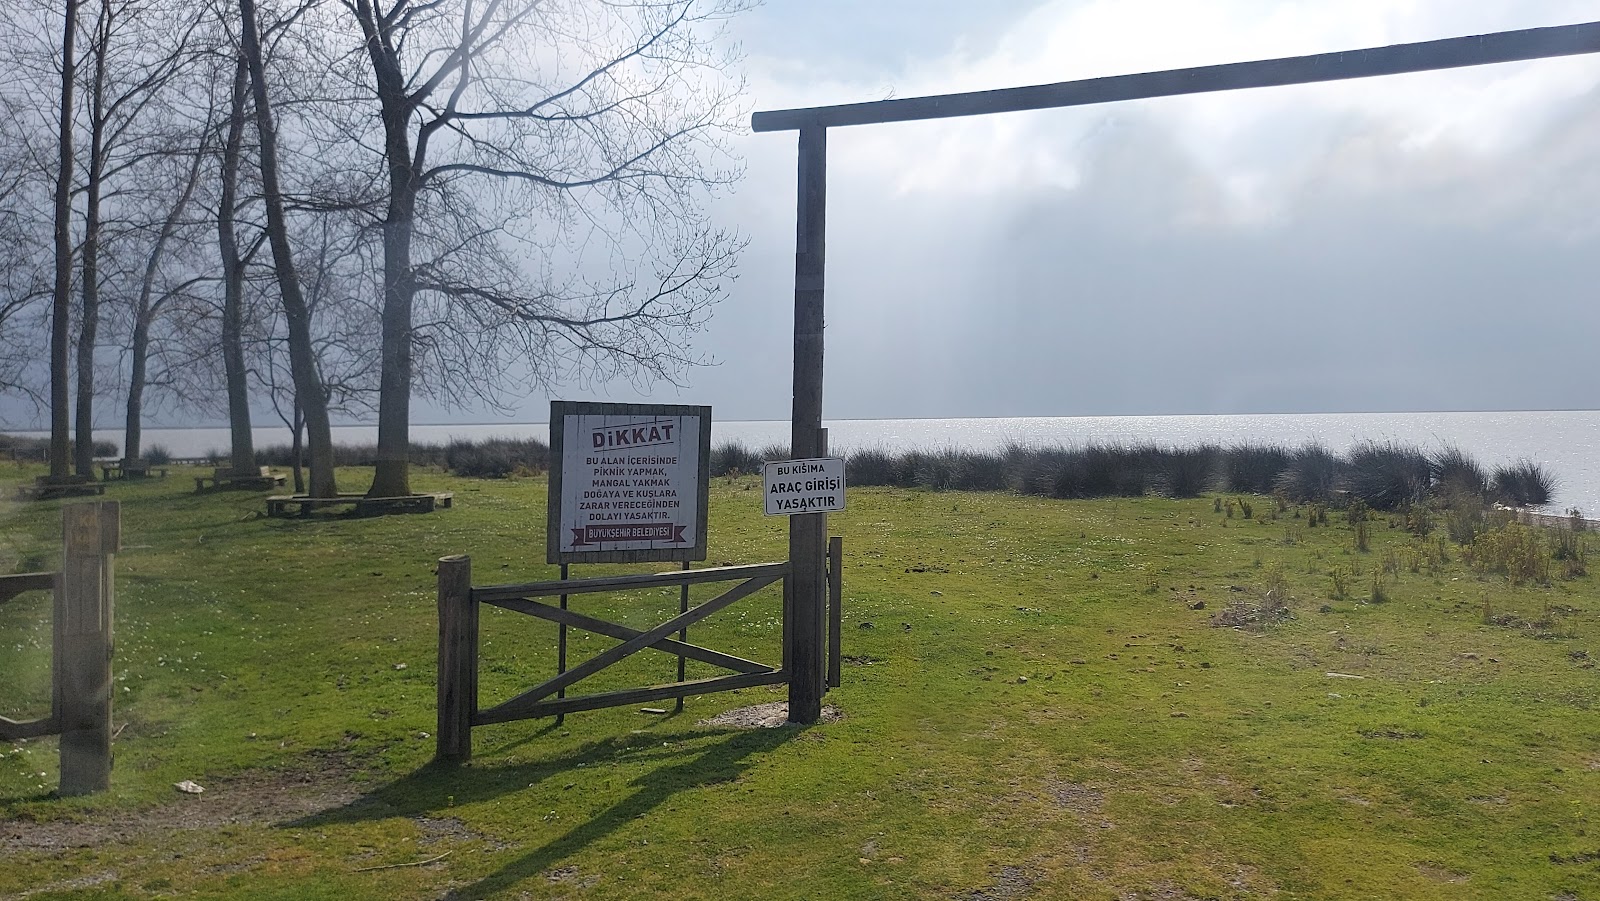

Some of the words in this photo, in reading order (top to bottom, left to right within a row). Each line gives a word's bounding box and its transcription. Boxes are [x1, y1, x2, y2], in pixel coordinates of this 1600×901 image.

[628, 455, 677, 465] İÇERİSİNDE
[594, 467, 625, 476] PİKNİK
[628, 468, 667, 476] YAPMAK,
[778, 467, 789, 475] BU
[770, 482, 802, 494] ARAÇ
[805, 476, 840, 491] GİRİŞİ
[584, 489, 620, 498] DOĞAYA
[637, 490, 676, 498] KUŞLARA
[612, 499, 679, 509] VERECEĞİNDEN
[776, 496, 835, 510] YASAKTIR
[624, 512, 670, 520] YASAKTIR.
